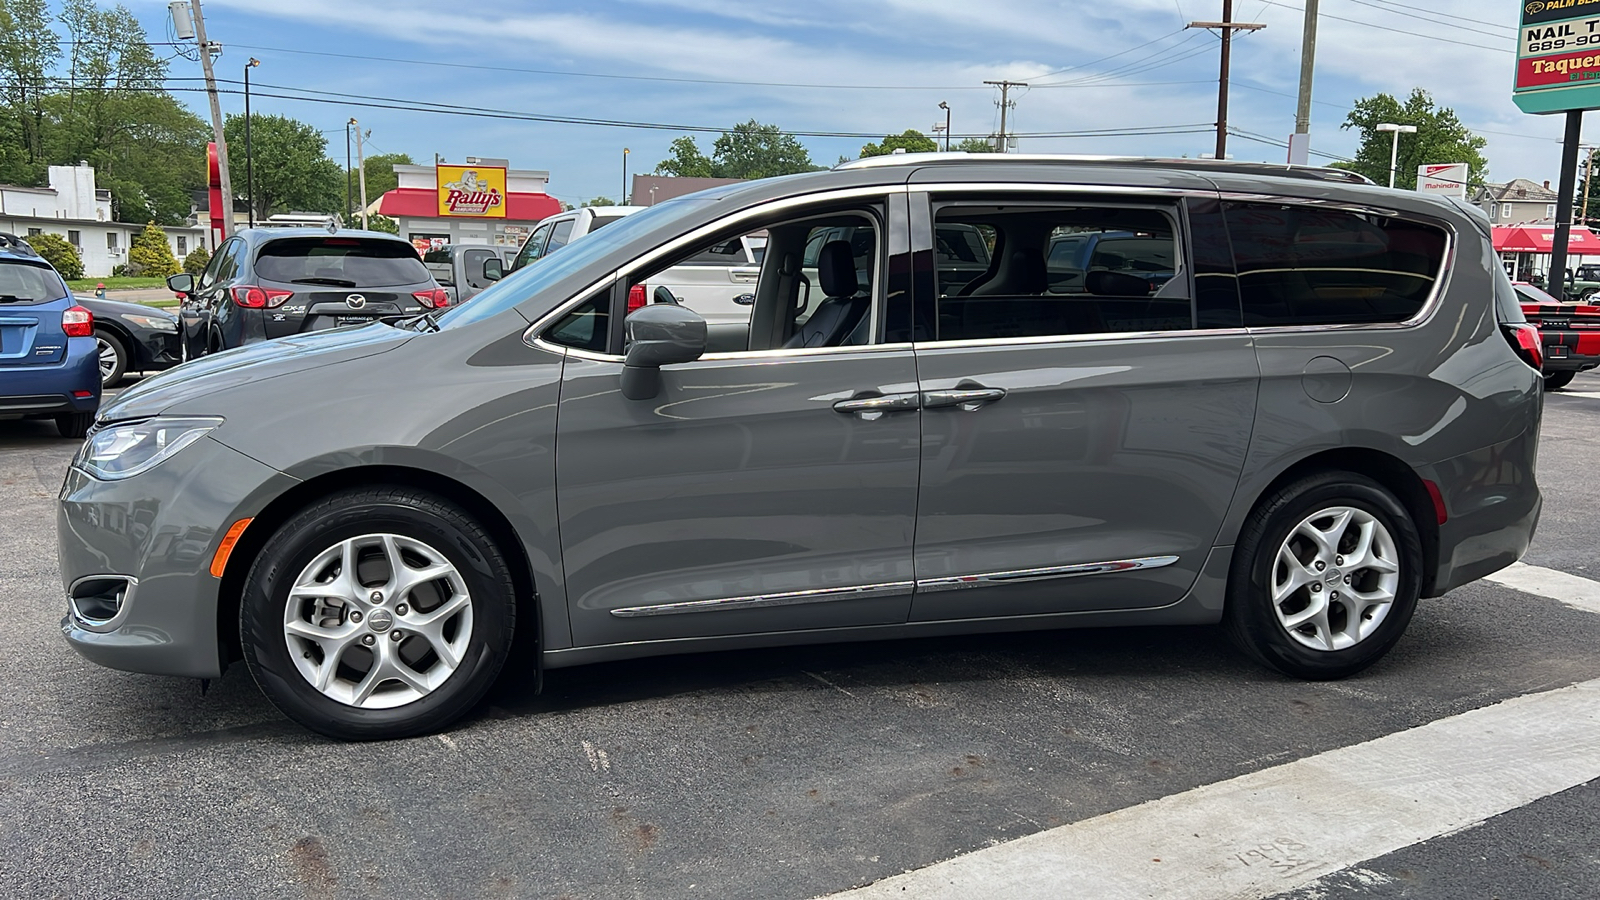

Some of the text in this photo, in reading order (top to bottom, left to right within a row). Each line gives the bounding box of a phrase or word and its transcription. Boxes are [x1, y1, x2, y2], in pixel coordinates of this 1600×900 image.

[1546, 0, 1574, 10] PALM
[1527, 24, 1575, 41] NAIL
[1528, 34, 1600, 52] 689-90
[445, 188, 501, 212] Rally's
